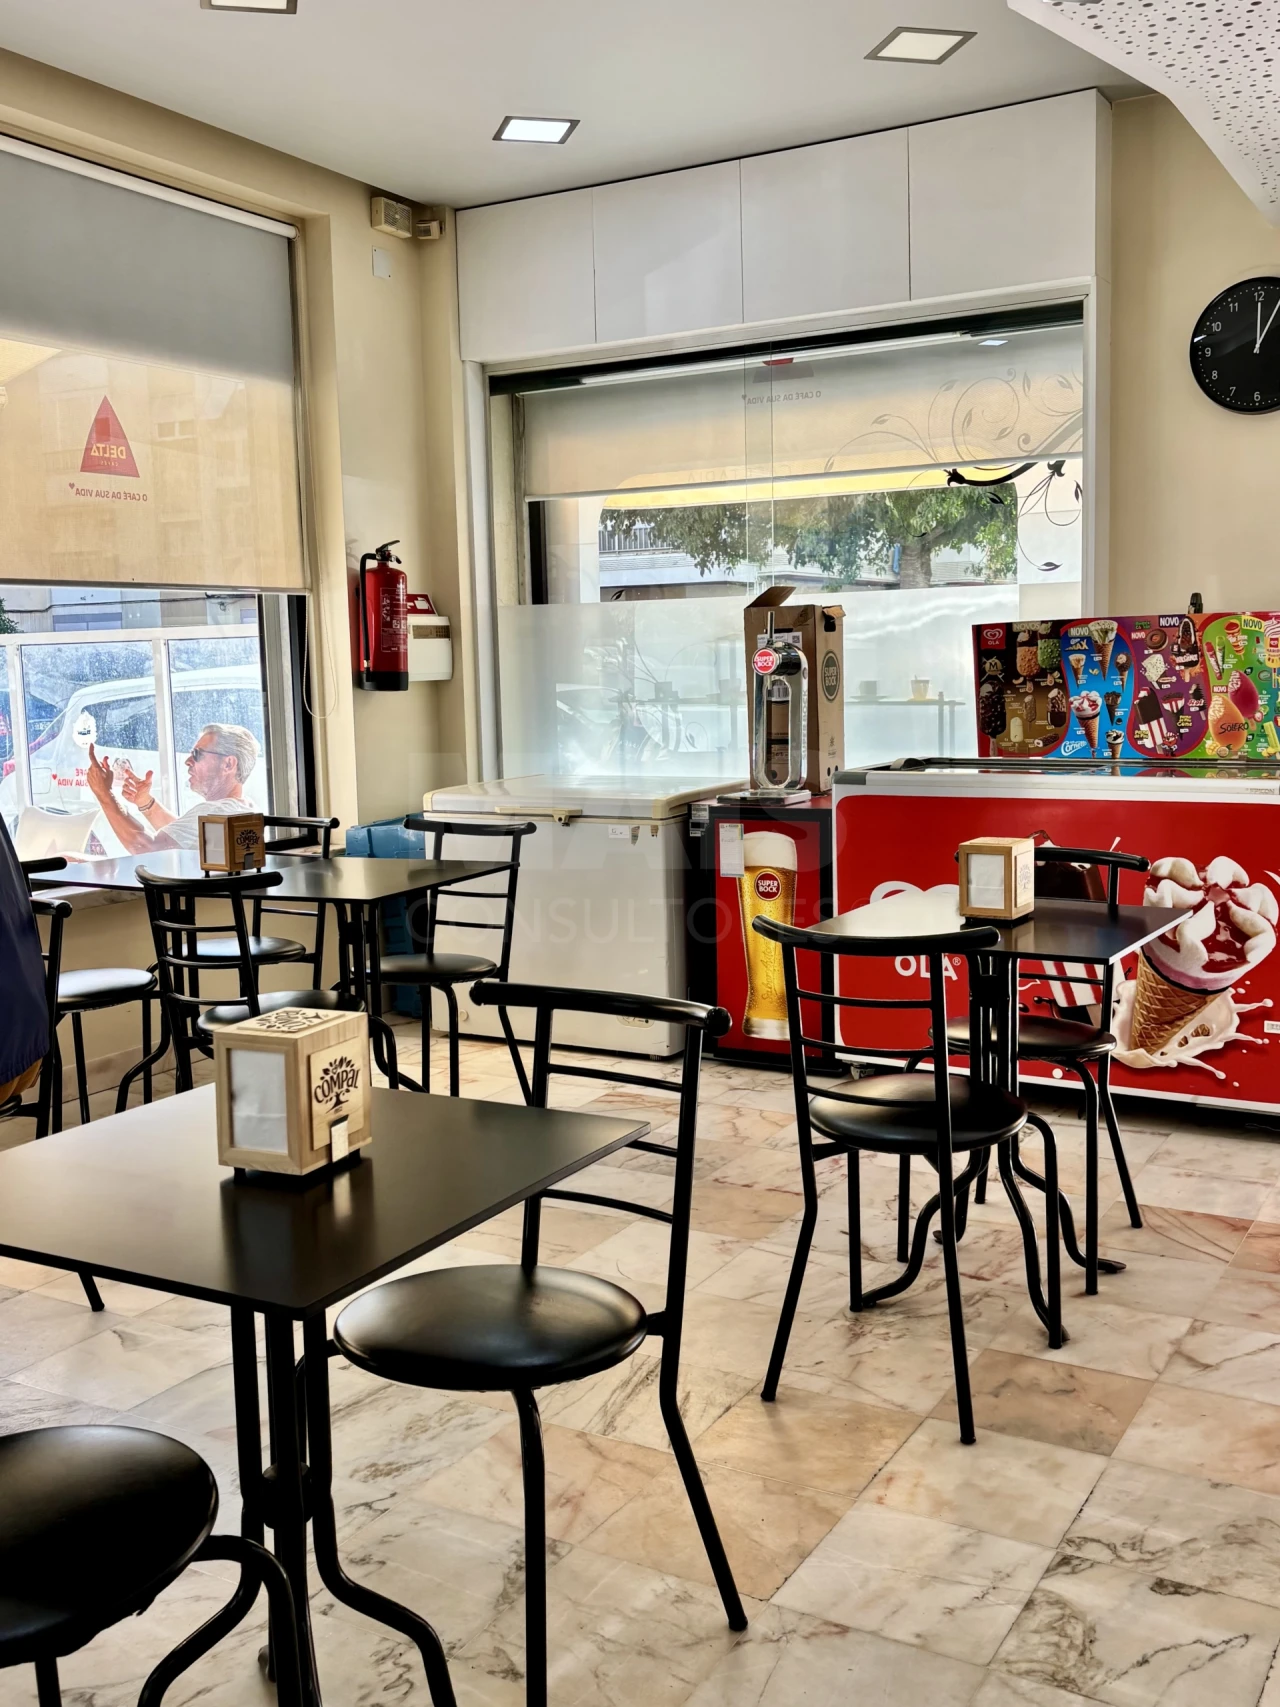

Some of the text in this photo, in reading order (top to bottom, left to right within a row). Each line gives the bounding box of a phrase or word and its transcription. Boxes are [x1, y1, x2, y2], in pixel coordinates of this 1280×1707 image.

[1253, 291, 1265, 301] 12
[1229, 302, 1239, 312] 11
[1211, 322, 1222, 332] 10
[1204, 347, 1212, 357] 9
[1211, 370, 1218, 380] 8
[1229, 387, 1236, 396] 7
[1253, 391, 1260, 401] 6
[1160, 616, 1180, 627] NOVO
[1244, 618, 1263, 630] NOVO
[1070, 626, 1089, 637] NOVO
[1131, 631, 1146, 640] NOVO
[824, 666, 837, 676] SUPER
[825, 676, 837, 686] BOCK
[1213, 685, 1227, 693] NOVO
[1219, 722, 1249, 734] SOLERO
[757, 879, 778, 887] SUPER
[758, 885, 778, 893] BOCK
